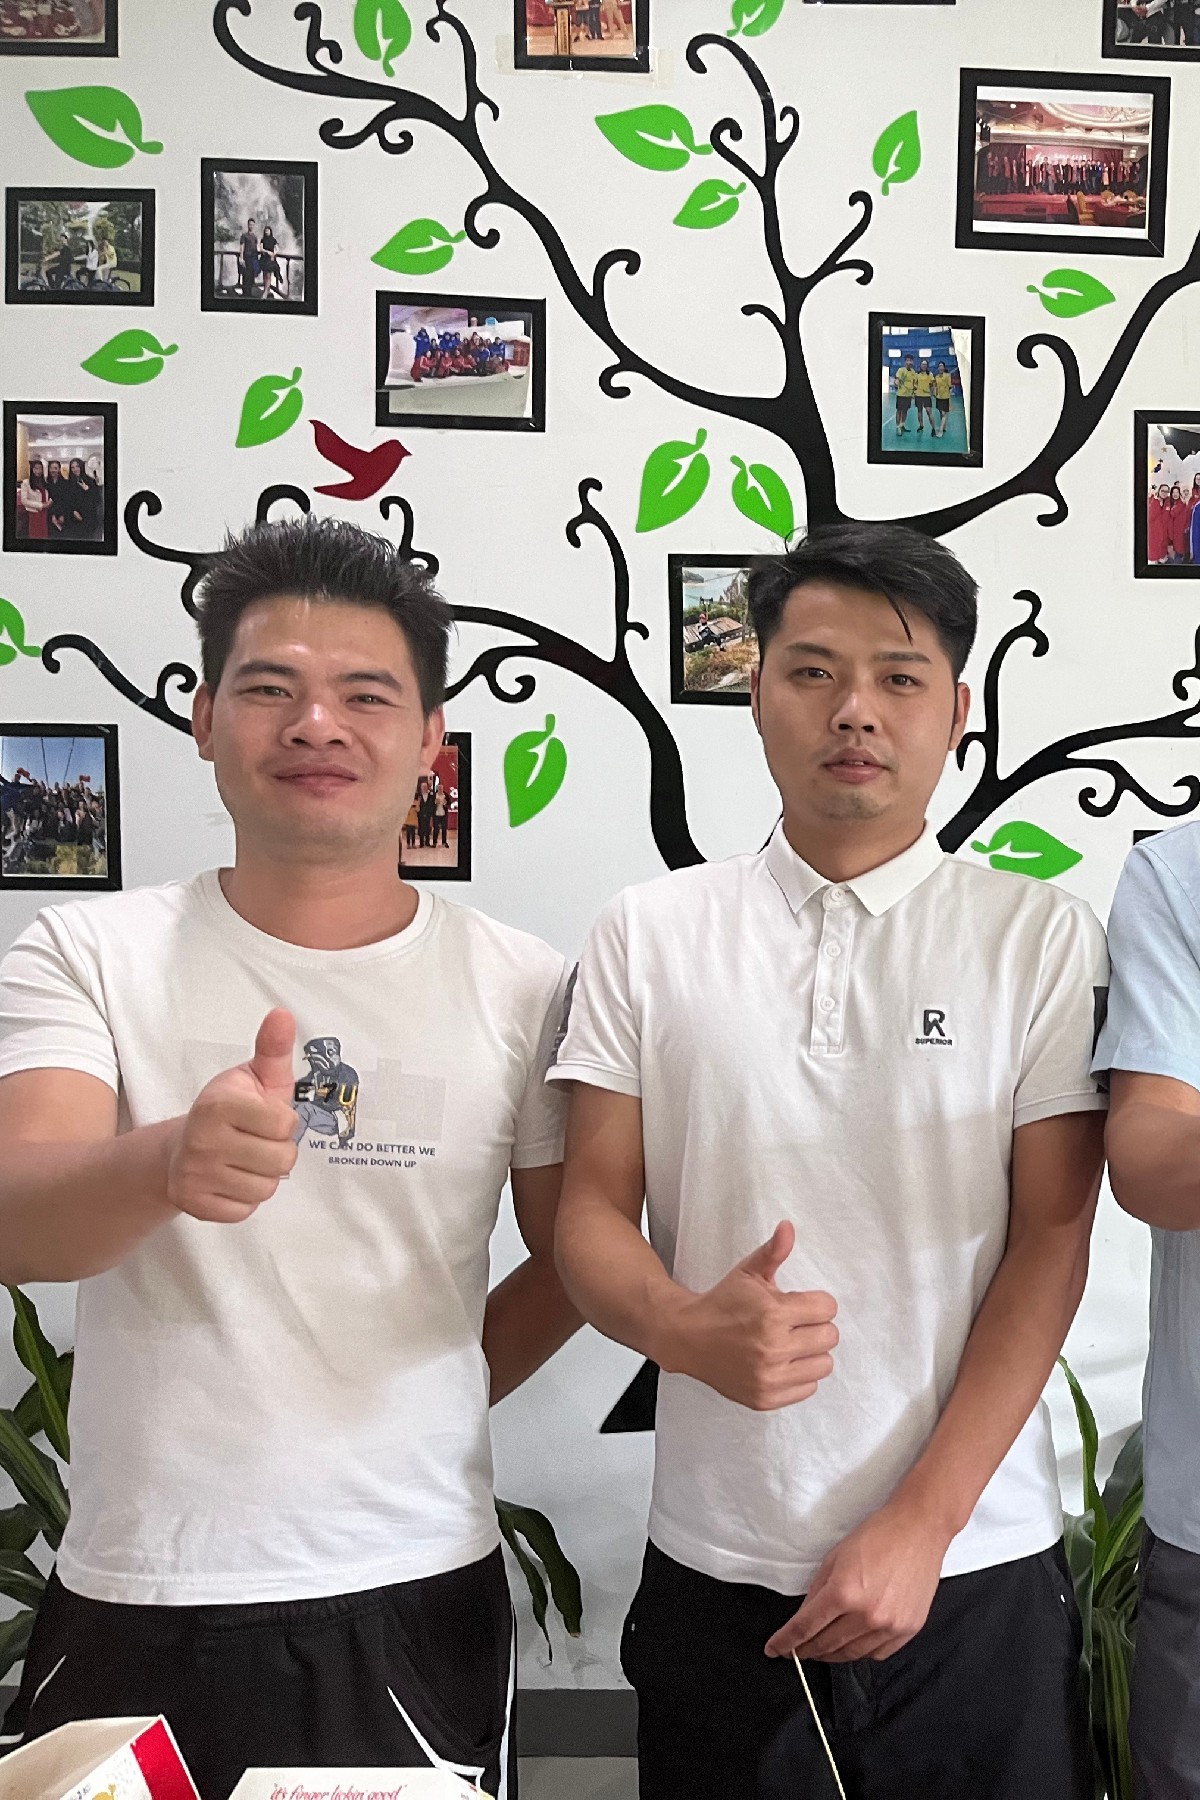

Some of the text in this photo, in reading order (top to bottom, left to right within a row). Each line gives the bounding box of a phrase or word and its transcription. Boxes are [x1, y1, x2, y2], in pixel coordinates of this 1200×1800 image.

[915, 1038, 953, 1046] SUPERIOR
[309, 1140, 435, 1156] WE CAN DO BETTER WE
[328, 1157, 368, 1166] BROKEN
[370, 1159, 401, 1168] DOWN
